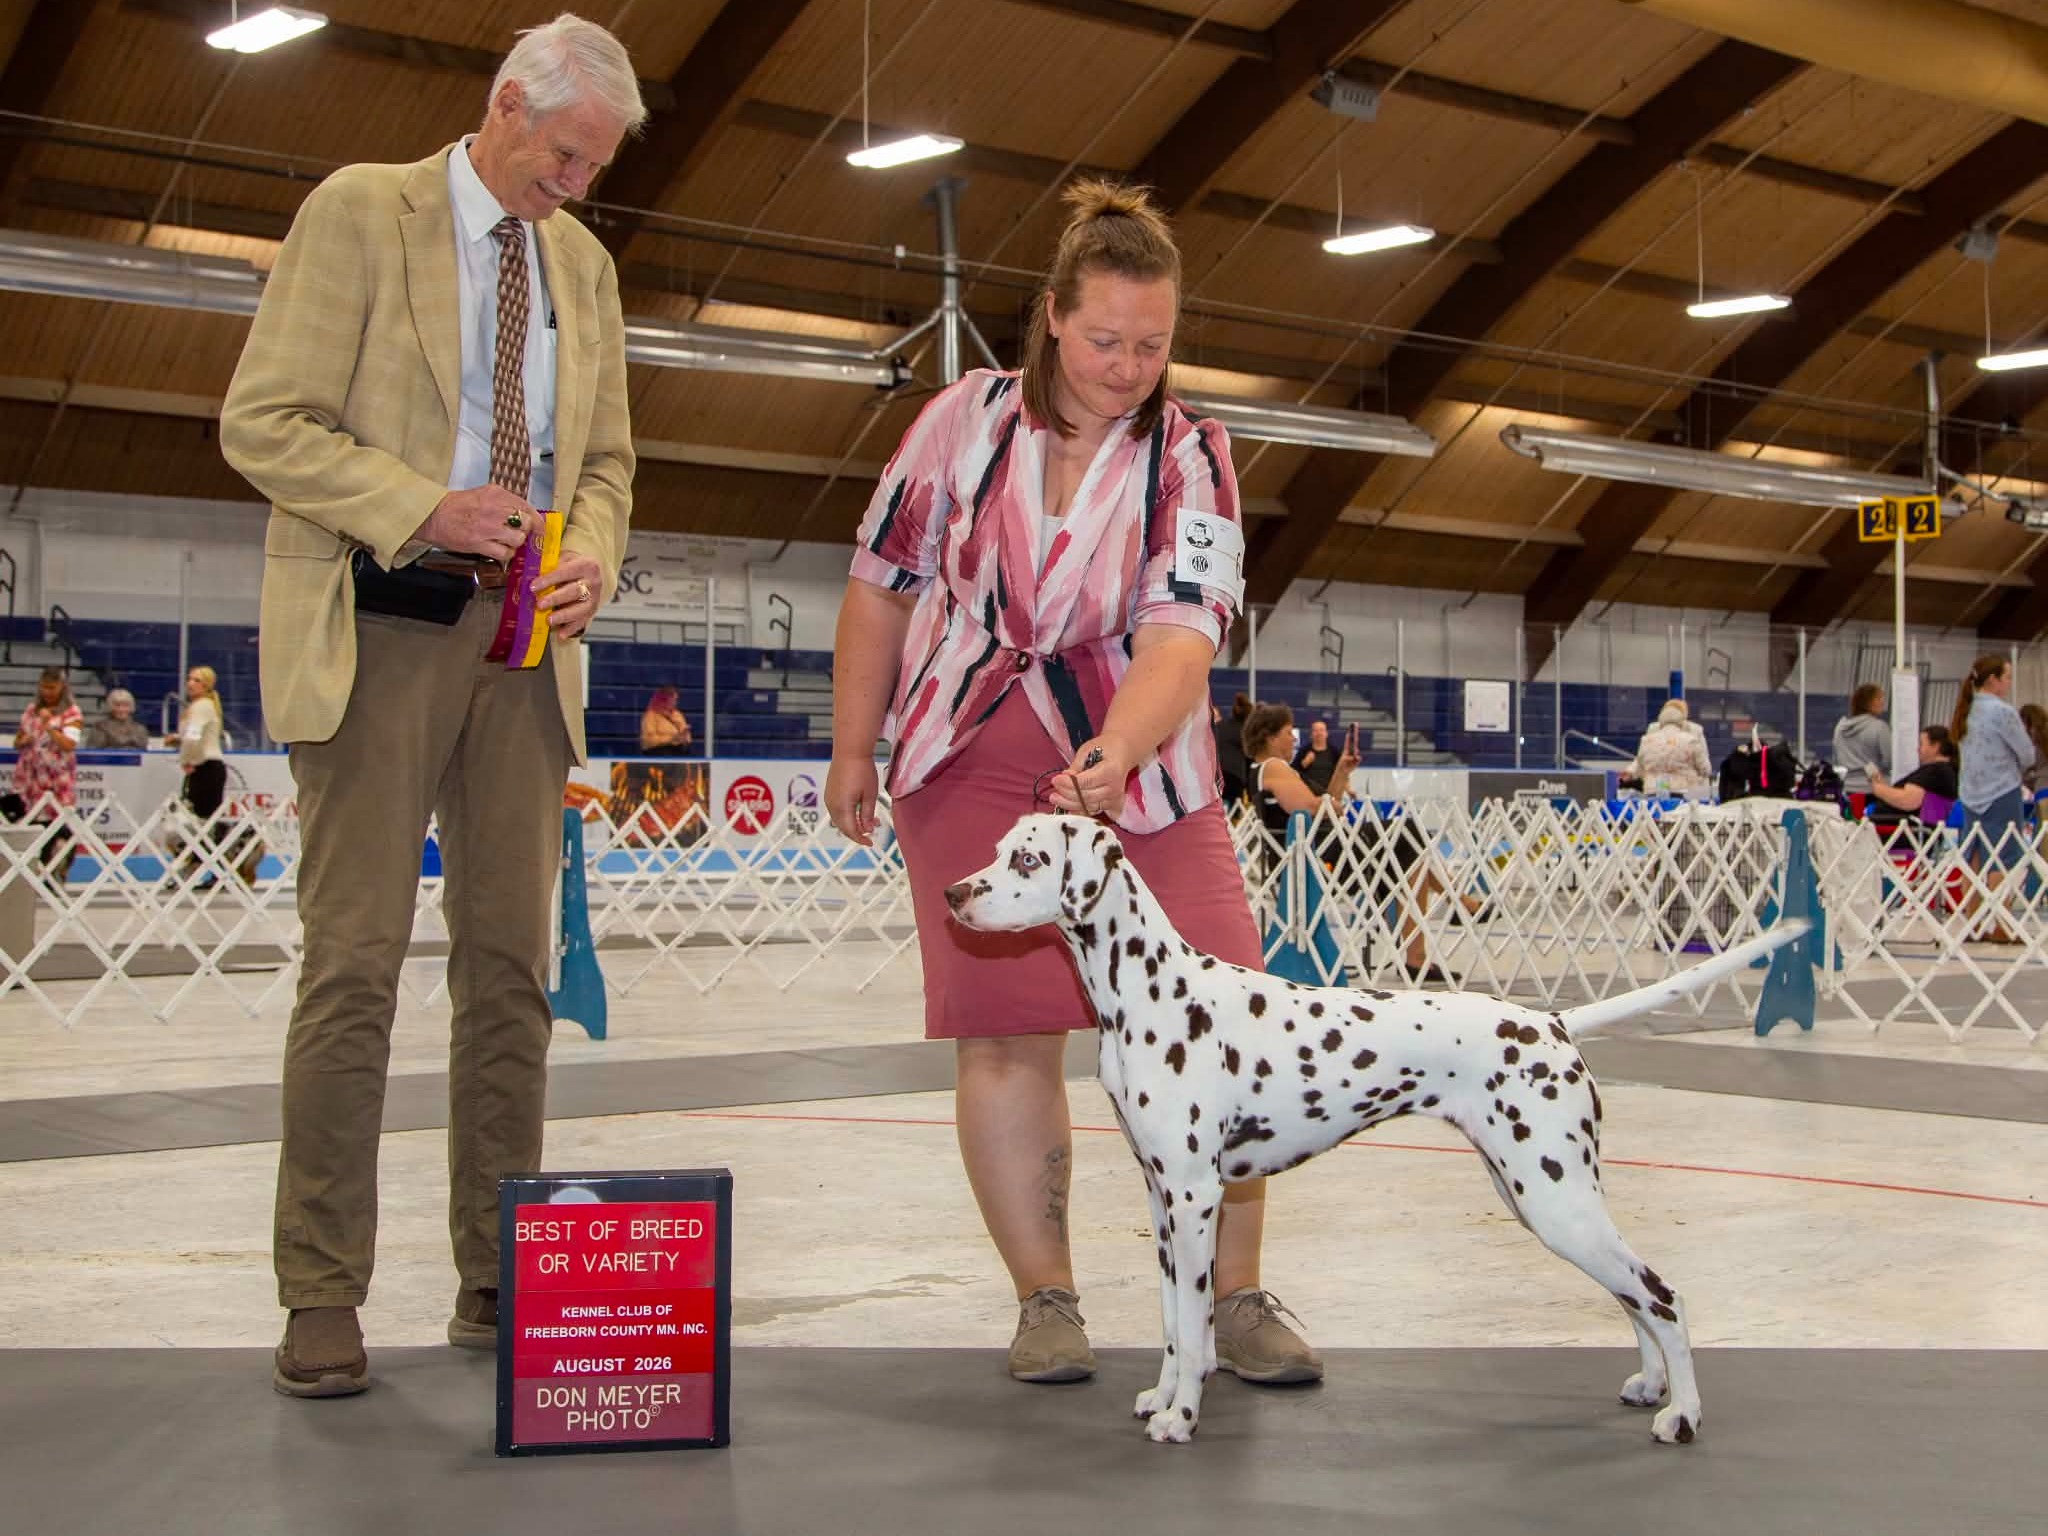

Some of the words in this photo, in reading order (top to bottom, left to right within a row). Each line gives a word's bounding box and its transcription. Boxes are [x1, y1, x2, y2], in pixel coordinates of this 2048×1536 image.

[1912, 503, 1929, 532] 2
[515, 1221, 577, 1242] BEST
[588, 1220, 619, 1241] OF
[630, 1219, 703, 1240] BREED
[538, 1253, 569, 1274] OR
[582, 1251, 680, 1273] VARIETY
[561, 1306, 614, 1318] KENNEL
[617, 1305, 652, 1317] CLUB
[655, 1304, 673, 1316] OF
[525, 1327, 597, 1339] FREEBORN
[600, 1325, 653, 1337] COUNTY
[656, 1324, 680, 1336] MN.
[683, 1323, 708, 1335] INC.
[552, 1358, 626, 1373] AUGUST
[634, 1356, 672, 1371] 2026
[536, 1387, 587, 1408] DON
[598, 1384, 681, 1407] MEYER
